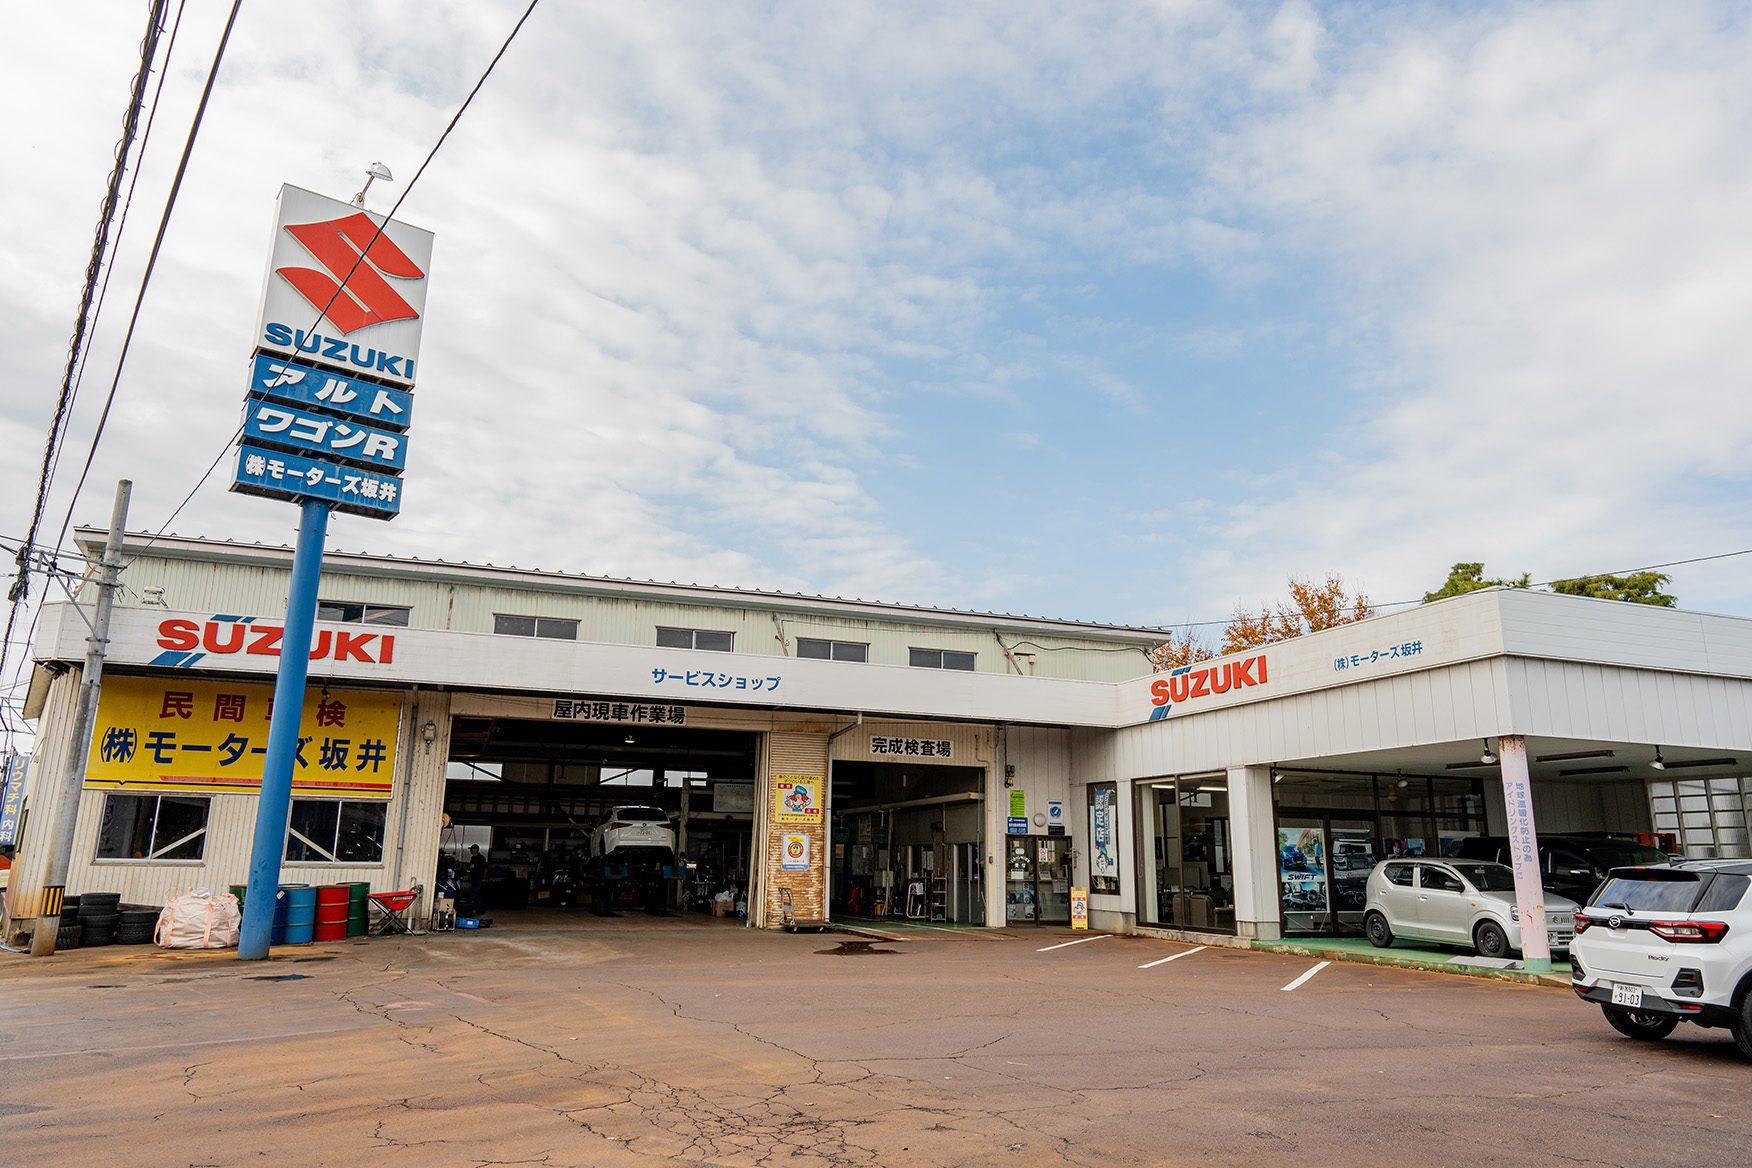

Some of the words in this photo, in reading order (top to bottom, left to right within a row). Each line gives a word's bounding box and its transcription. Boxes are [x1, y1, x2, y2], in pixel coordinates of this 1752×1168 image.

[264, 322, 415, 379] SUZUKI
[262, 364, 403, 414] アルト
[256, 407, 400, 461] ワゴンR
[1333, 640, 1423, 671] (株)モーターズ坂井
[652, 668, 782, 691] サービスショップ
[1150, 655, 1268, 706] SUZUKI
[159, 690, 348, 729] 民間検
[554, 700, 686, 725] 屋内現車作業場
[872, 737, 951, 757] 完成検査場
[4, 759, 25, 815] リウマチ科
[0, 819, 14, 842] 内科
[1505, 782, 1524, 879] アイドリングストップに
[1515, 782, 1533, 862] 地球温暖化防止の為
[1287, 873, 1317, 881] SWIFT
[1648, 954, 1670, 962] Rocky
